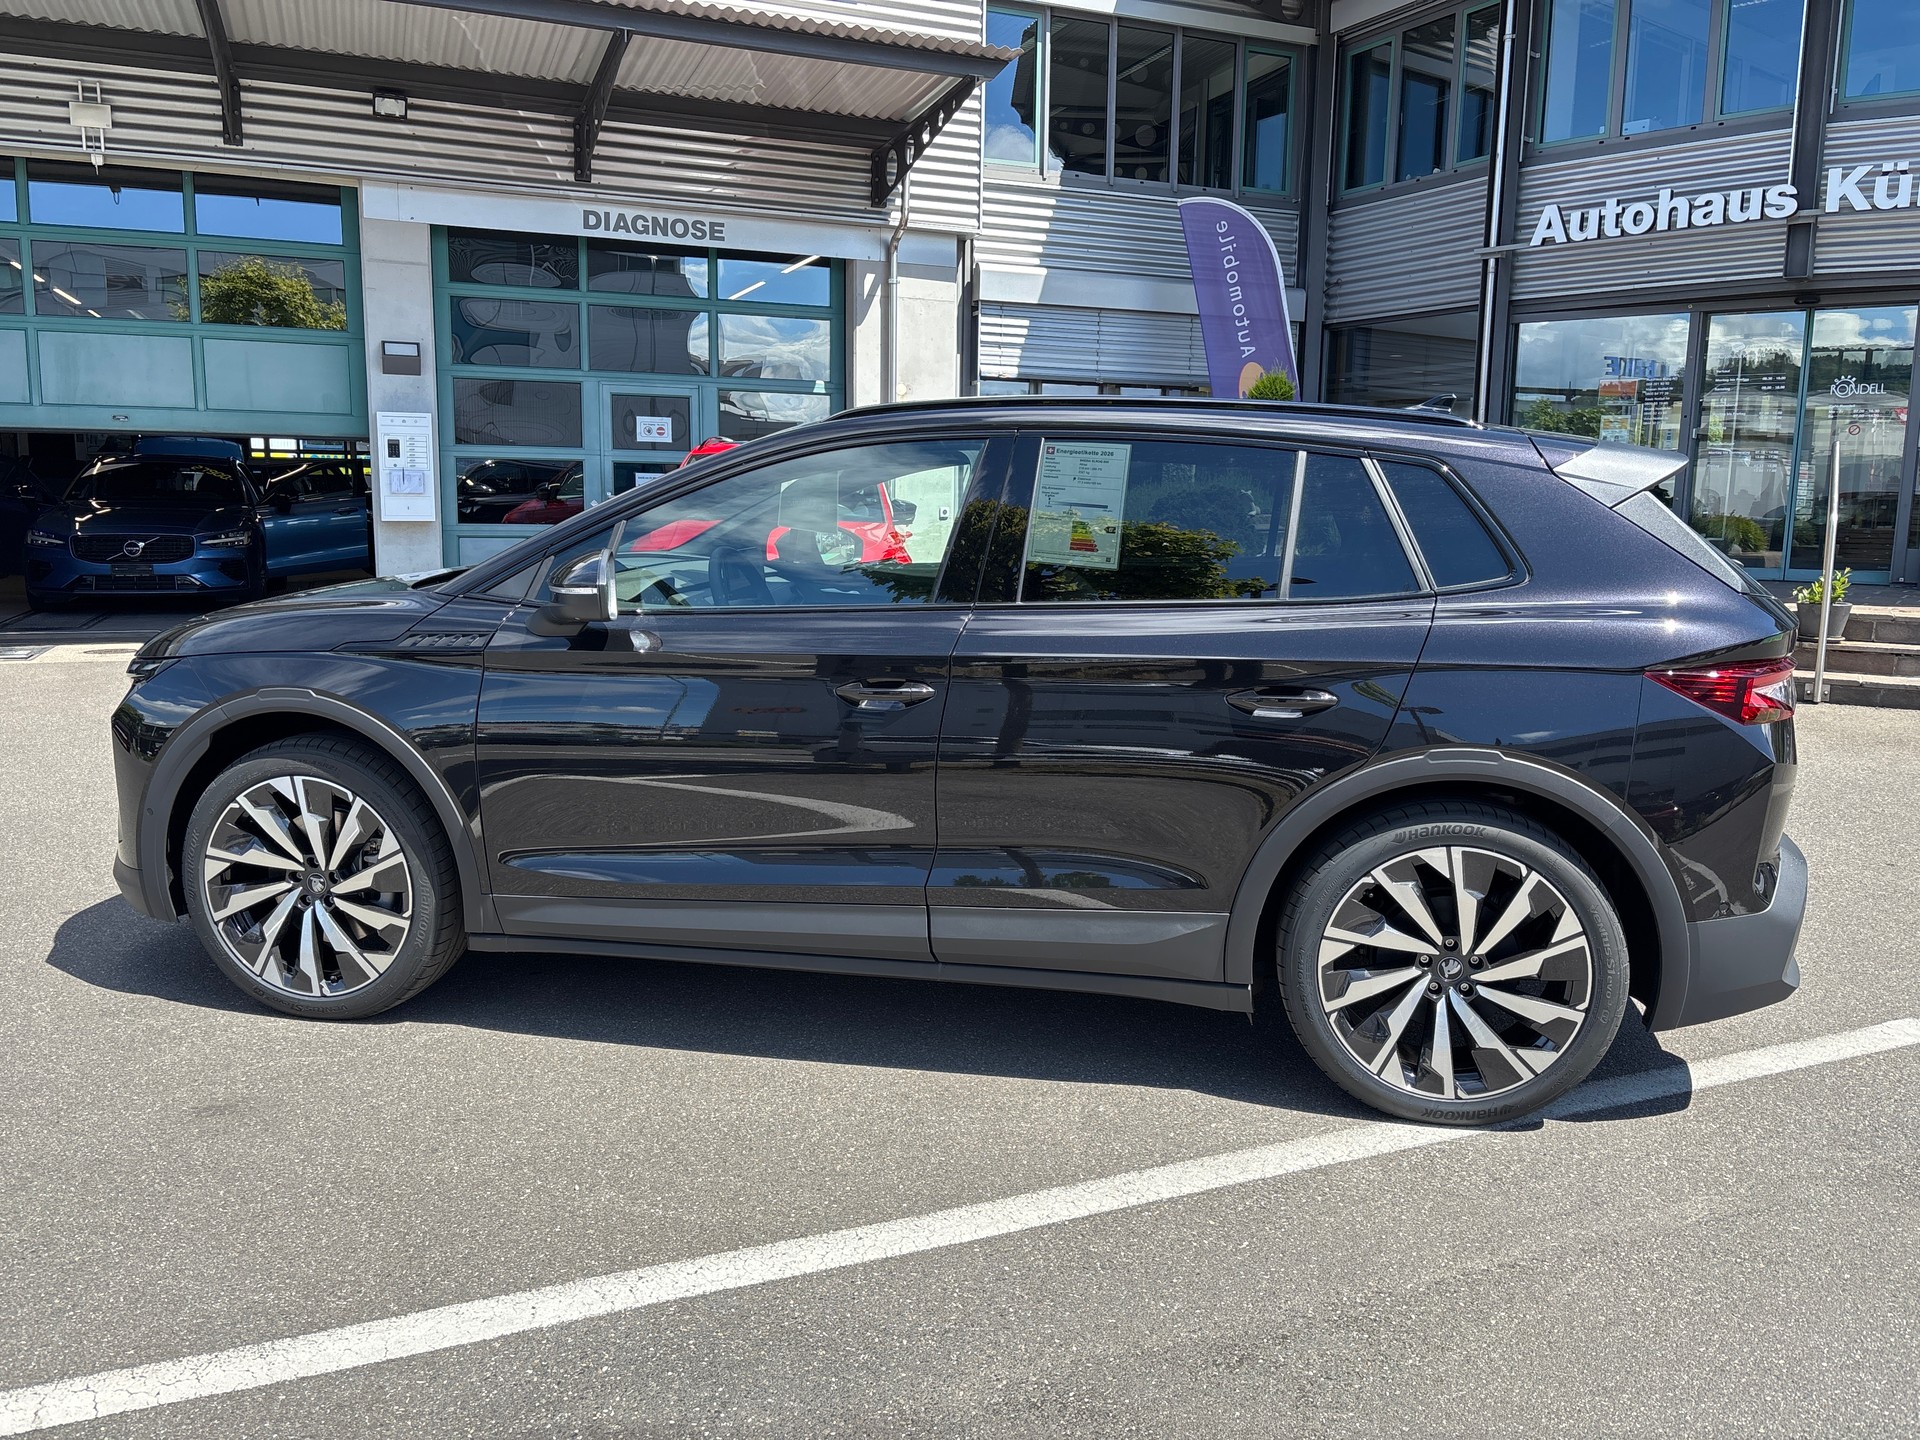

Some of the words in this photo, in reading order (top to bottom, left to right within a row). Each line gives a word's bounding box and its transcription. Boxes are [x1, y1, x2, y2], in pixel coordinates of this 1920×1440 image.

[1529, 183, 1799, 246] Autohaus
[1824, 161, 1920, 214] Kü
[582, 209, 726, 242] DIAGNOSE
[1830, 382, 1887, 397] RONDELL
